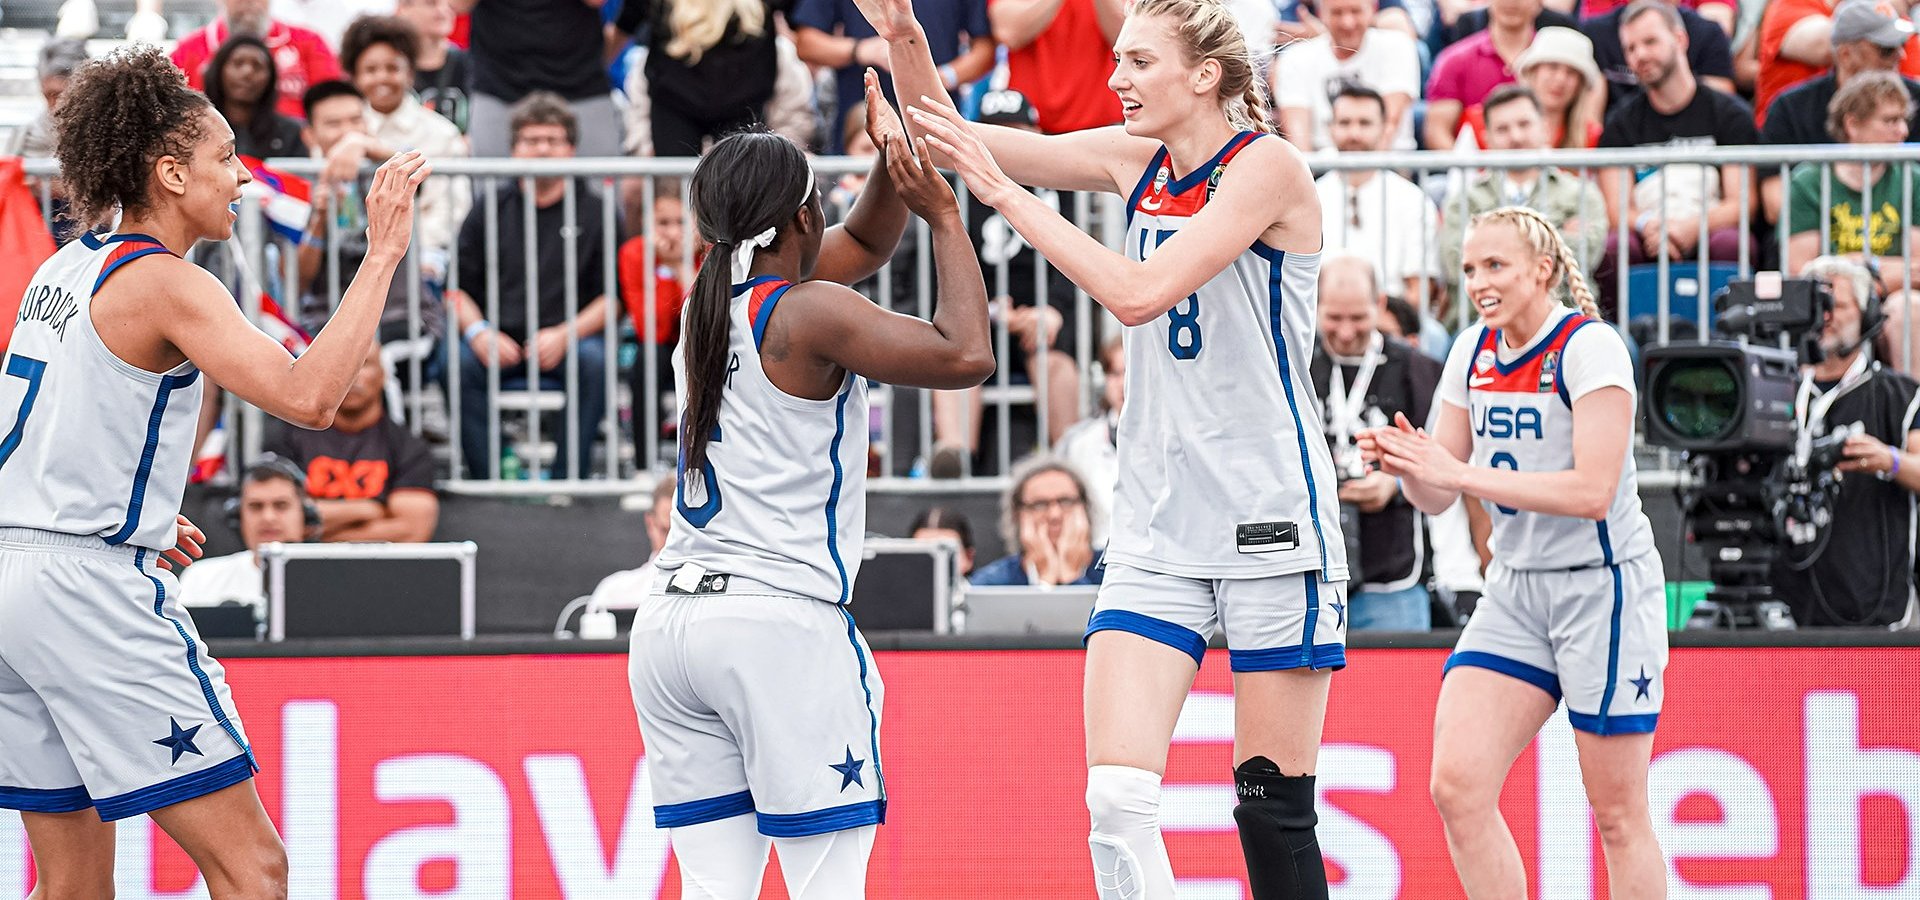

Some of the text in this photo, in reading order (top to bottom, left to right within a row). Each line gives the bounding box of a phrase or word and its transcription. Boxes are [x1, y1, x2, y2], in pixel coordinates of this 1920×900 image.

[15, 284, 79, 343] URDICK
[1167, 291, 1203, 361] 8
[0, 352, 49, 471] 7
[1471, 403, 1543, 440] USA
